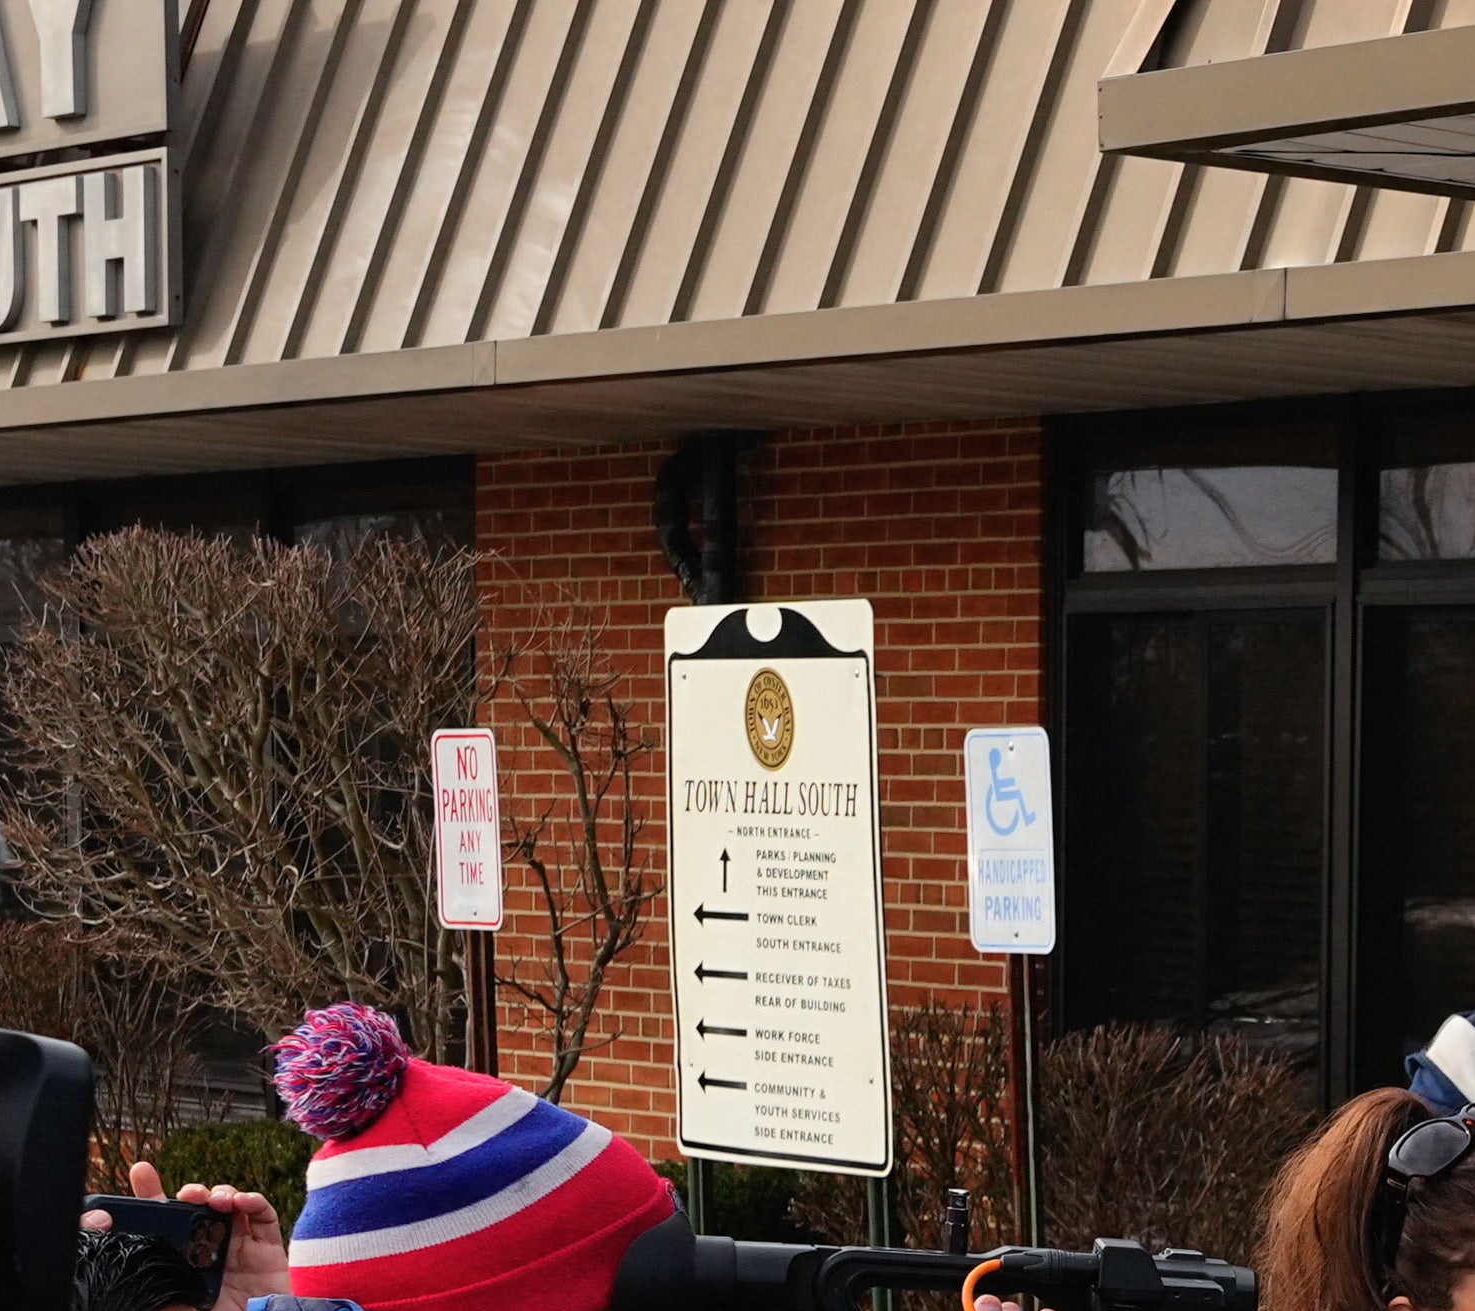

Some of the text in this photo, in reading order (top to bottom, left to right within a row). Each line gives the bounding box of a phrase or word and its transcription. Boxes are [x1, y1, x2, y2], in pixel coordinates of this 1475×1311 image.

[457, 746, 478, 780] NO
[442, 789, 493, 823] PARKING
[685, 780, 858, 817] TOWN HALL SOUTH
[737, 826, 811, 839] NORTH ENTRANCE
[460, 830, 482, 853] ANY
[756, 850, 786, 861] PARKS
[793, 851, 836, 863] PLANNING
[459, 862, 484, 885] TIME
[766, 868, 829, 881] DEVELOPMENT
[978, 859, 1046, 884] HANDICAPPED
[756, 886, 827, 900] THIS ENTRANCE
[985, 896, 1041, 921] PARKING
[756, 913, 817, 926] TOWN CLERK
[756, 938, 841, 953] SOUTH ENTRANCE
[755, 972, 851, 989] RECEIVER OF TAXES
[755, 996, 846, 1013] REAR OF BUILDING
[755, 1029, 820, 1044] WORK FORCE
[755, 1050, 834, 1067] SIDE ENTRANCE
[755, 1083, 816, 1098] COMMUNITY
[755, 1104, 840, 1123] YOUTH SERVICES
[755, 1126, 833, 1145] SIDE ENTRANCE
